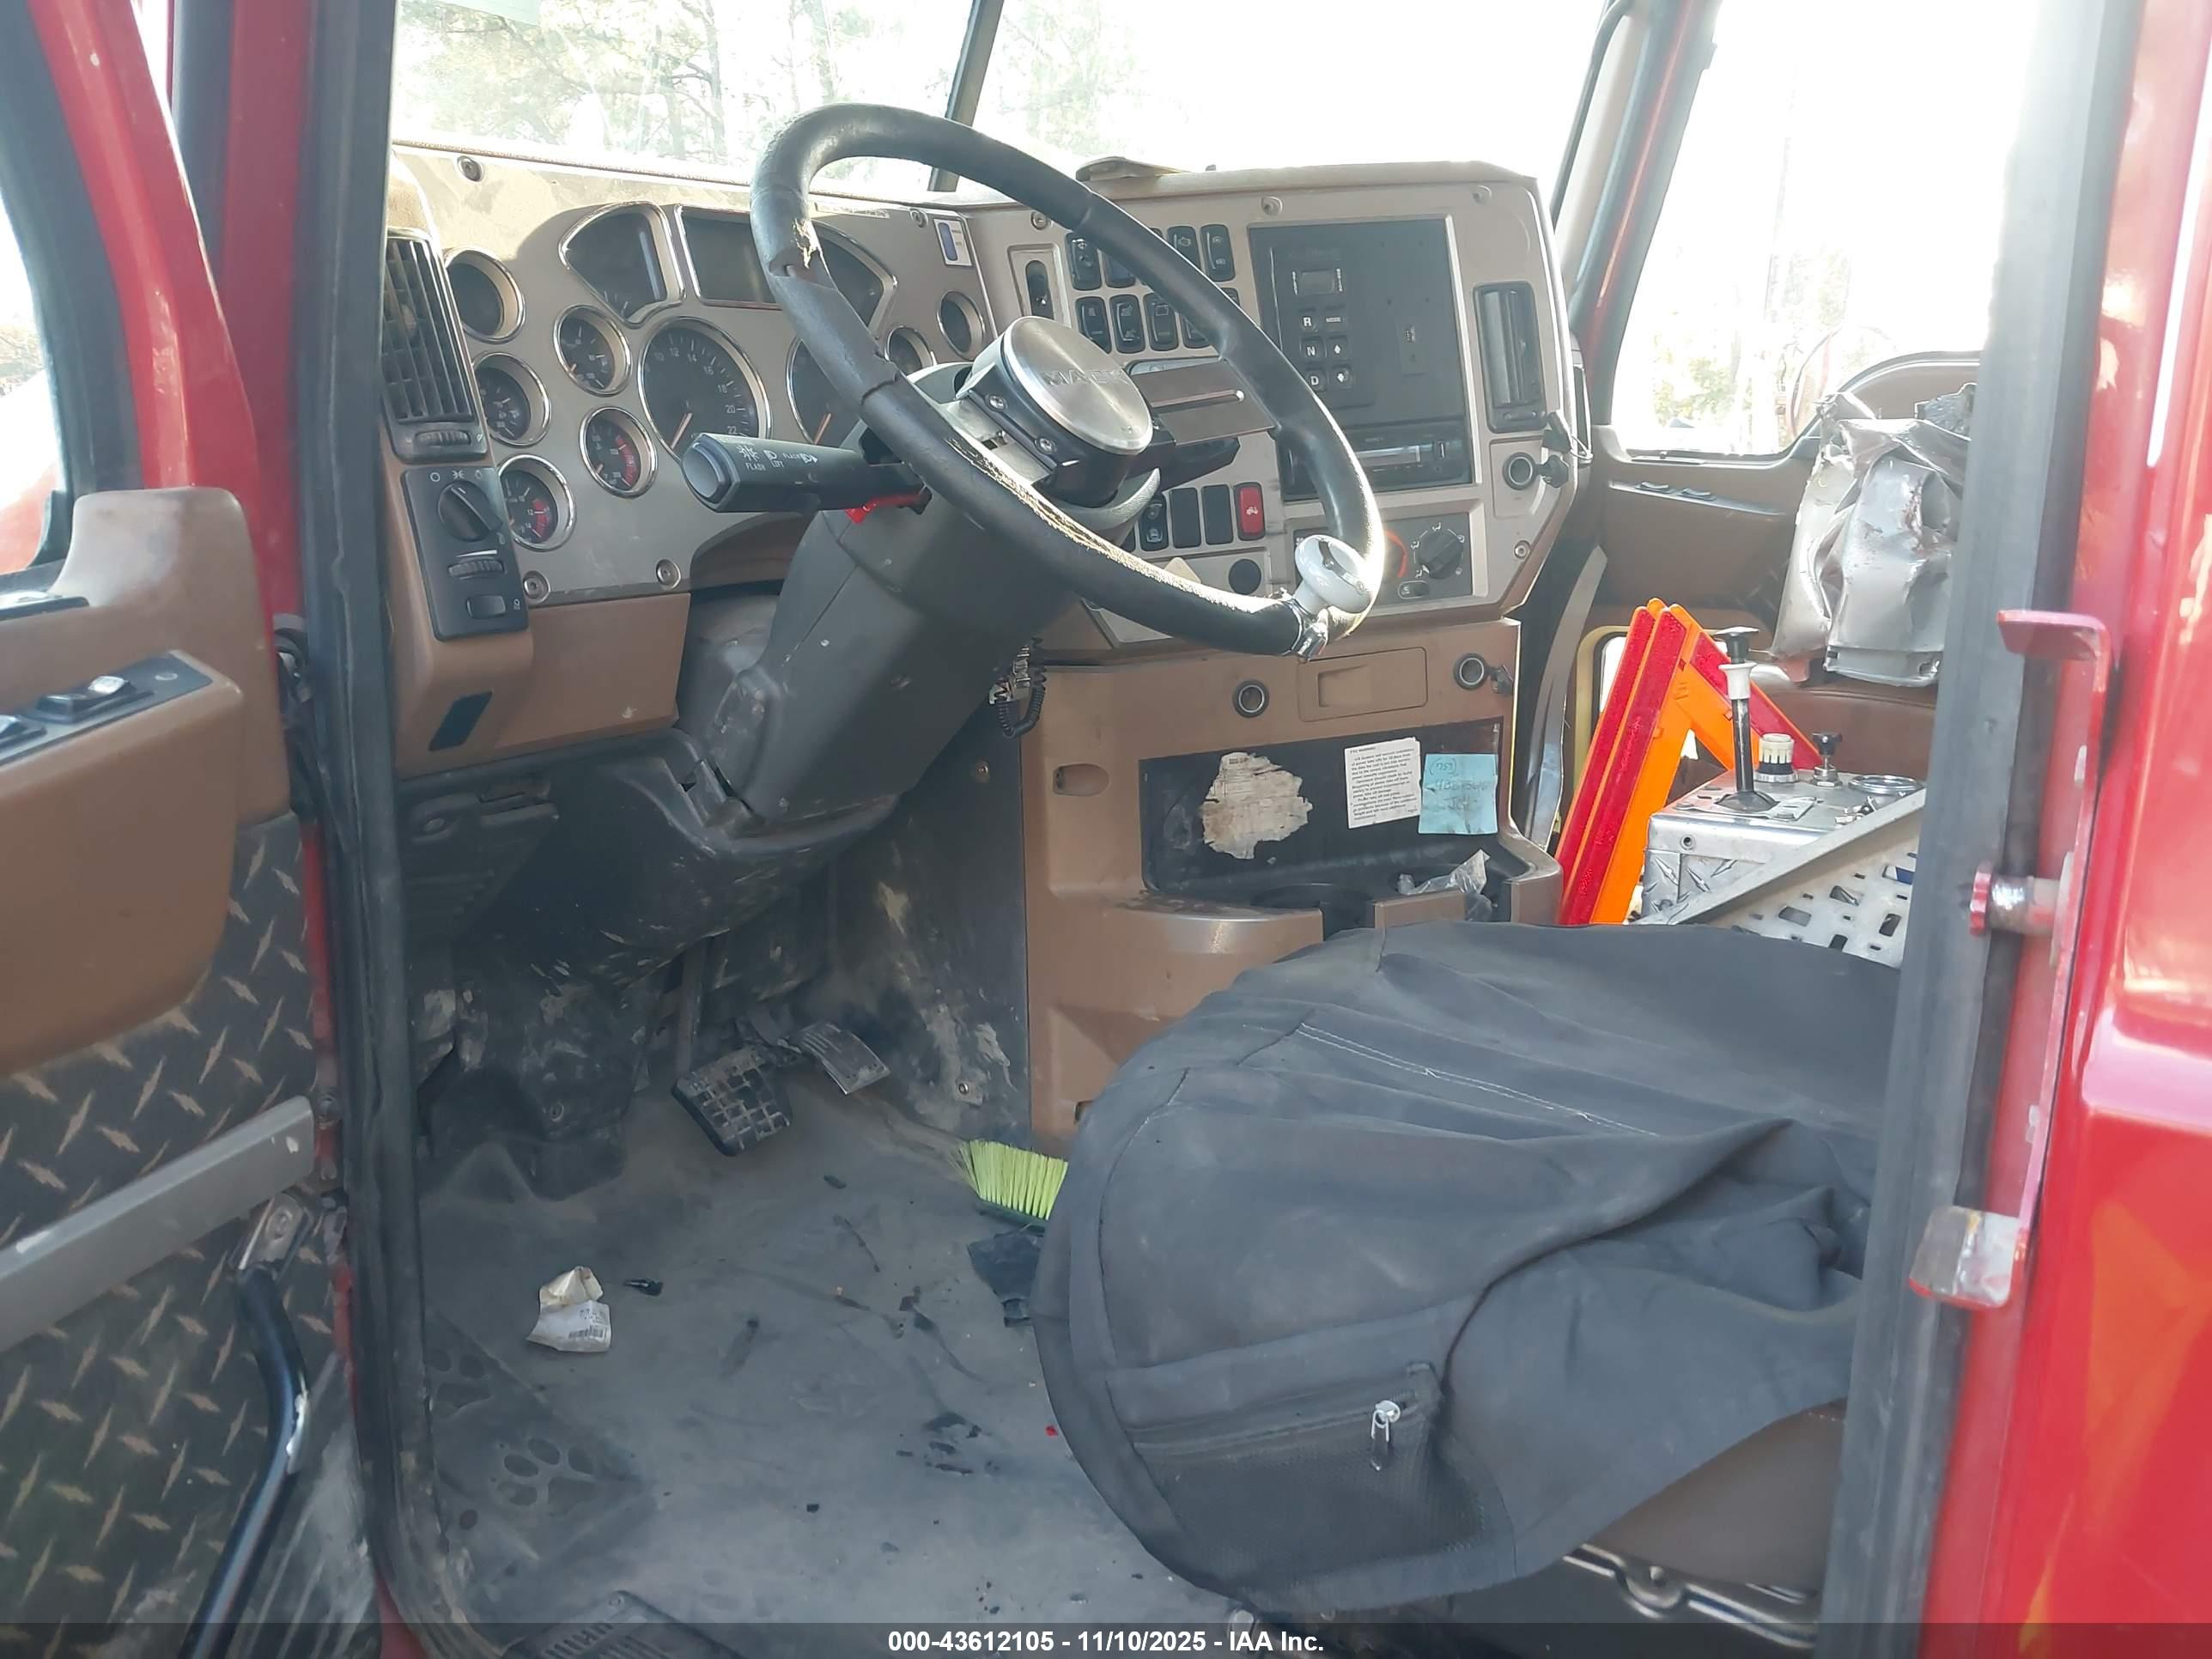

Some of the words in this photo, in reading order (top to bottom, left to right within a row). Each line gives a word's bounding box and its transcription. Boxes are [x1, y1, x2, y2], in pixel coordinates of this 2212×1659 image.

[1303, 317, 1312, 326] R
[1307, 346, 1316, 356] N
[687, 354, 697, 362] 14
[703, 366, 714, 375] 16
[1310, 376, 1319, 386] D
[717, 384, 727, 394] 18
[725, 404, 736, 414] 20
[726, 425, 738, 434] 22
